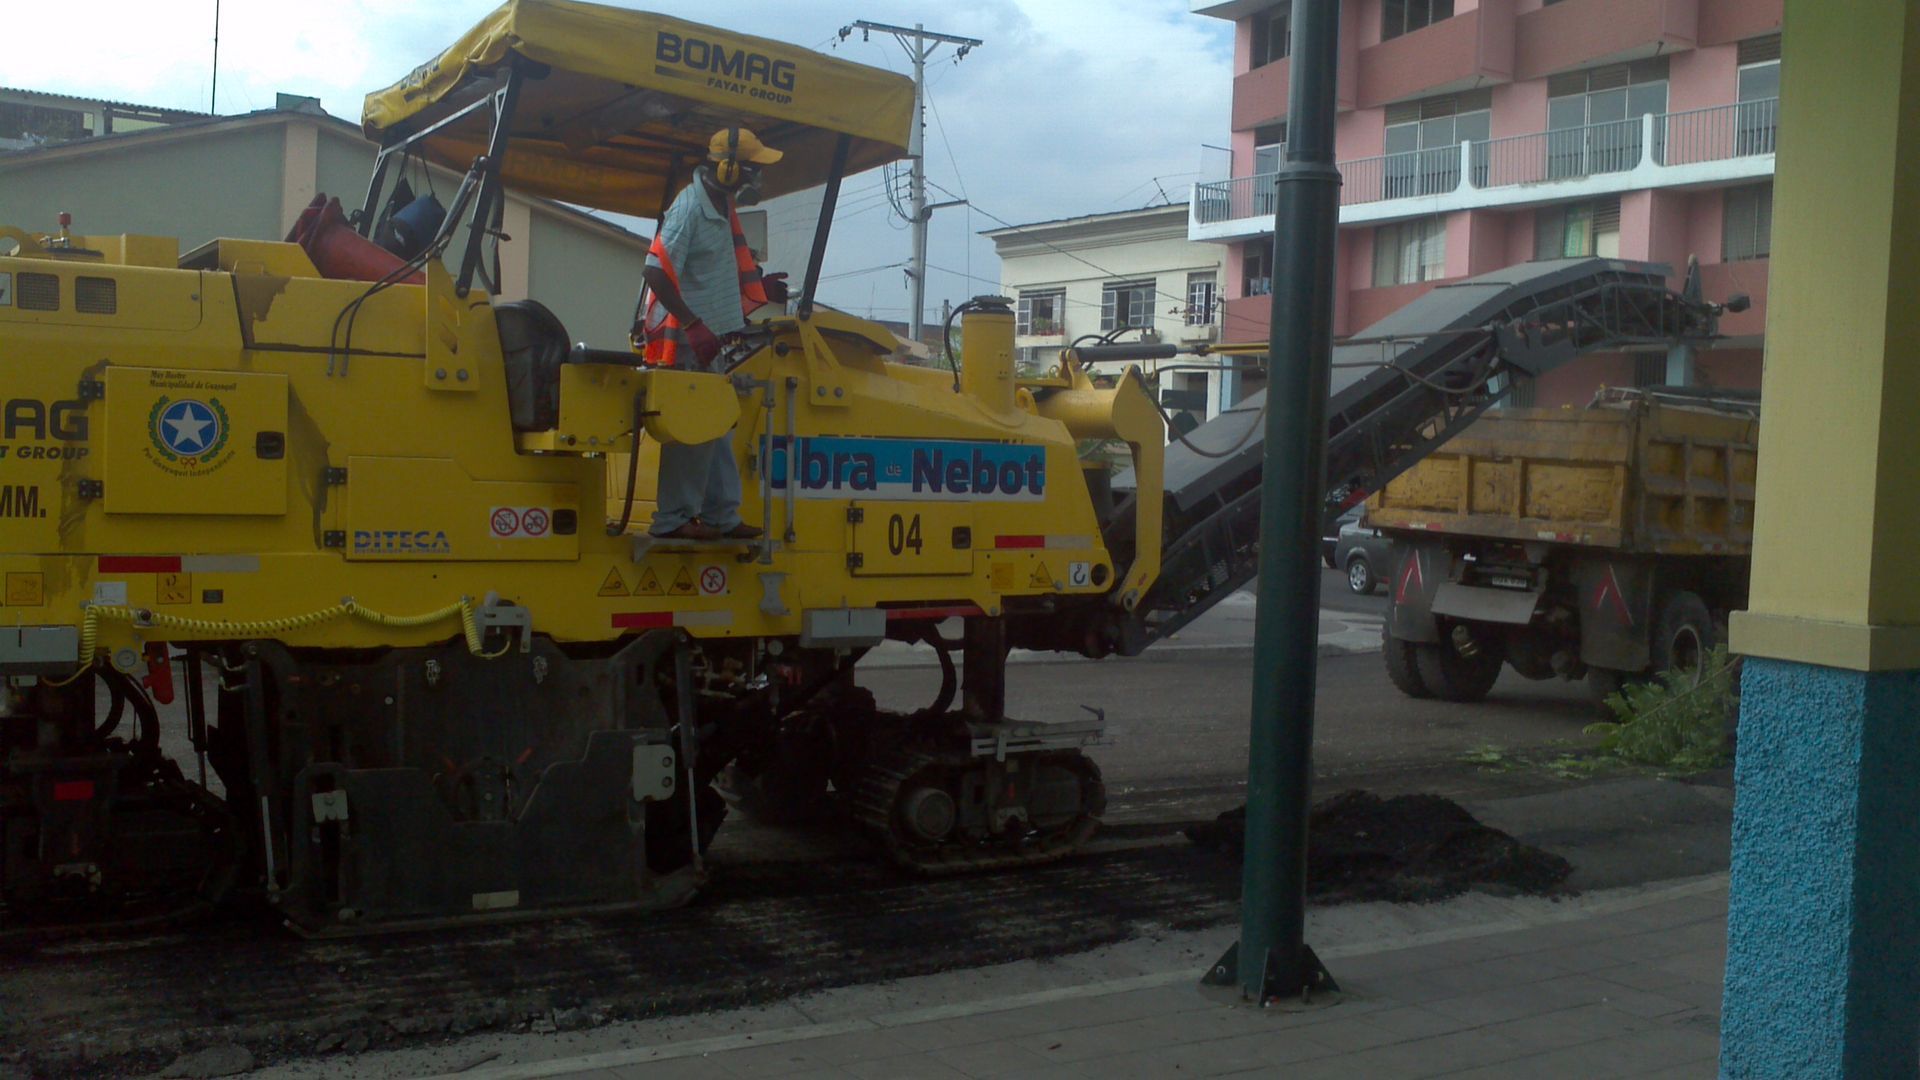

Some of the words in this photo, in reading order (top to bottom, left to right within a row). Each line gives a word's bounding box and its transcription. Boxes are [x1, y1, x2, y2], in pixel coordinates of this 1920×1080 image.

[655, 31, 796, 92] BOMAG
[707, 77, 747, 95] FAYAT
[749, 87, 793, 105] GROUP
[195, 381, 203, 389] de
[4, 398, 89, 441] AG
[16, 446, 90, 460] GROUP
[886, 457, 903, 476] de
[912, 447, 1044, 496] Nebot
[354, 530, 450, 548] DITECA
[888, 513, 923, 556] 04
